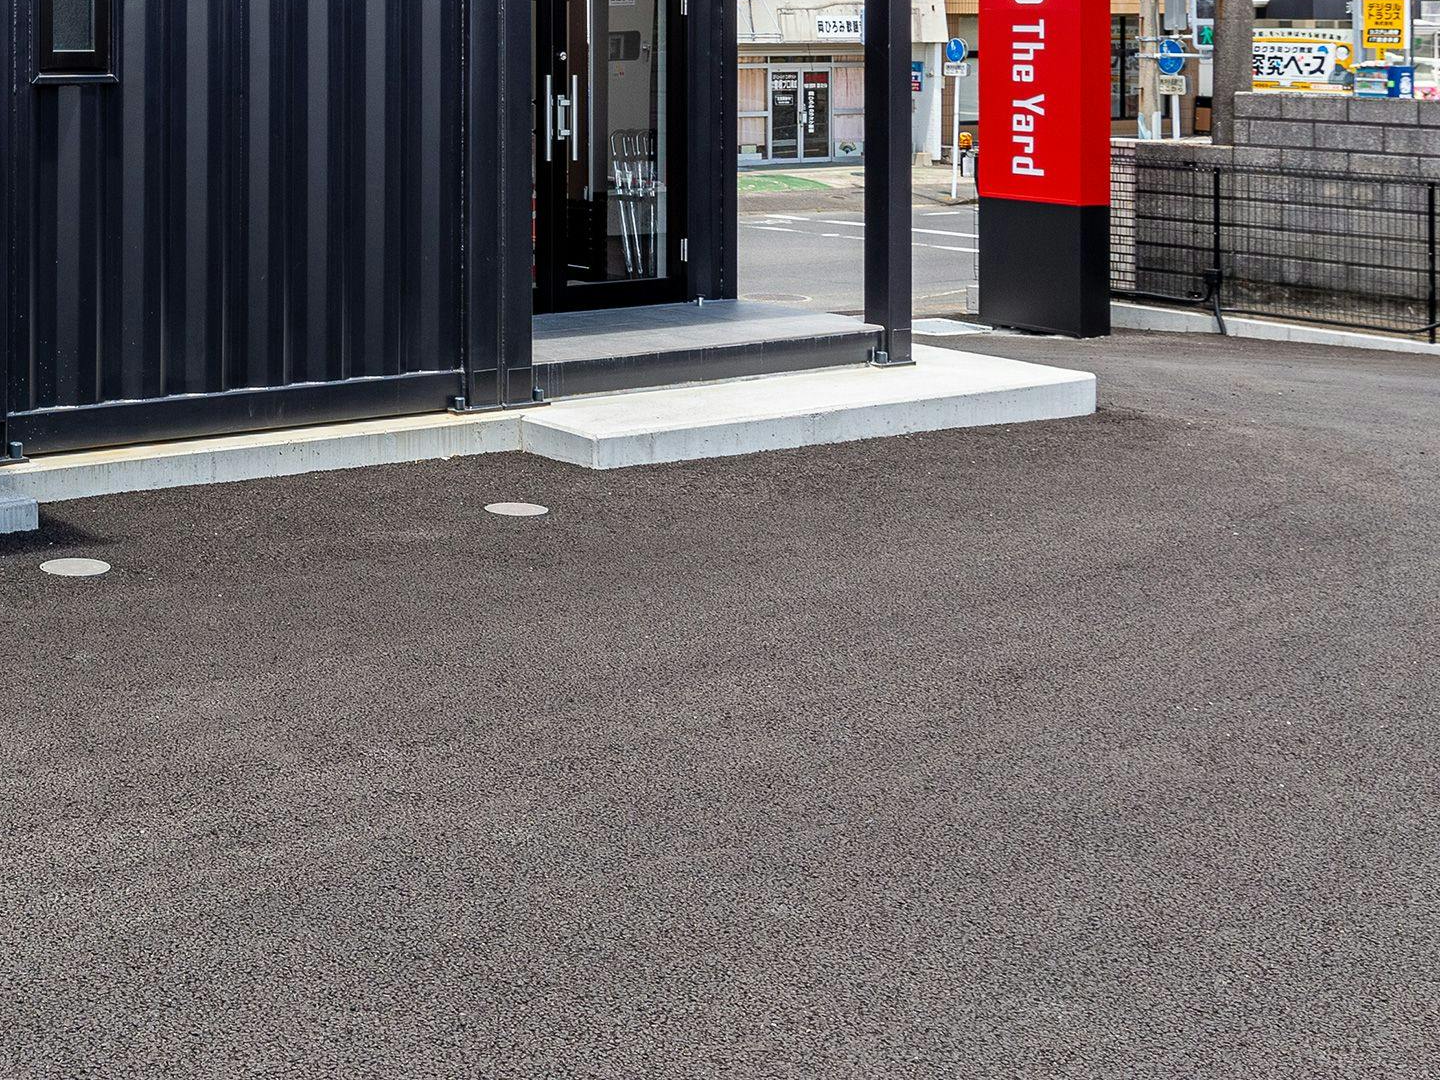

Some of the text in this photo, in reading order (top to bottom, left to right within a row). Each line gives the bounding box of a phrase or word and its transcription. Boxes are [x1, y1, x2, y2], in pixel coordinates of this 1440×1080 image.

[1368, 3, 1401, 11] デジタル
[1368, 11, 1401, 20] トランス
[1253, 45, 1313, 53] ログラミング教室
[1011, 18, 1045, 177] The Yard
